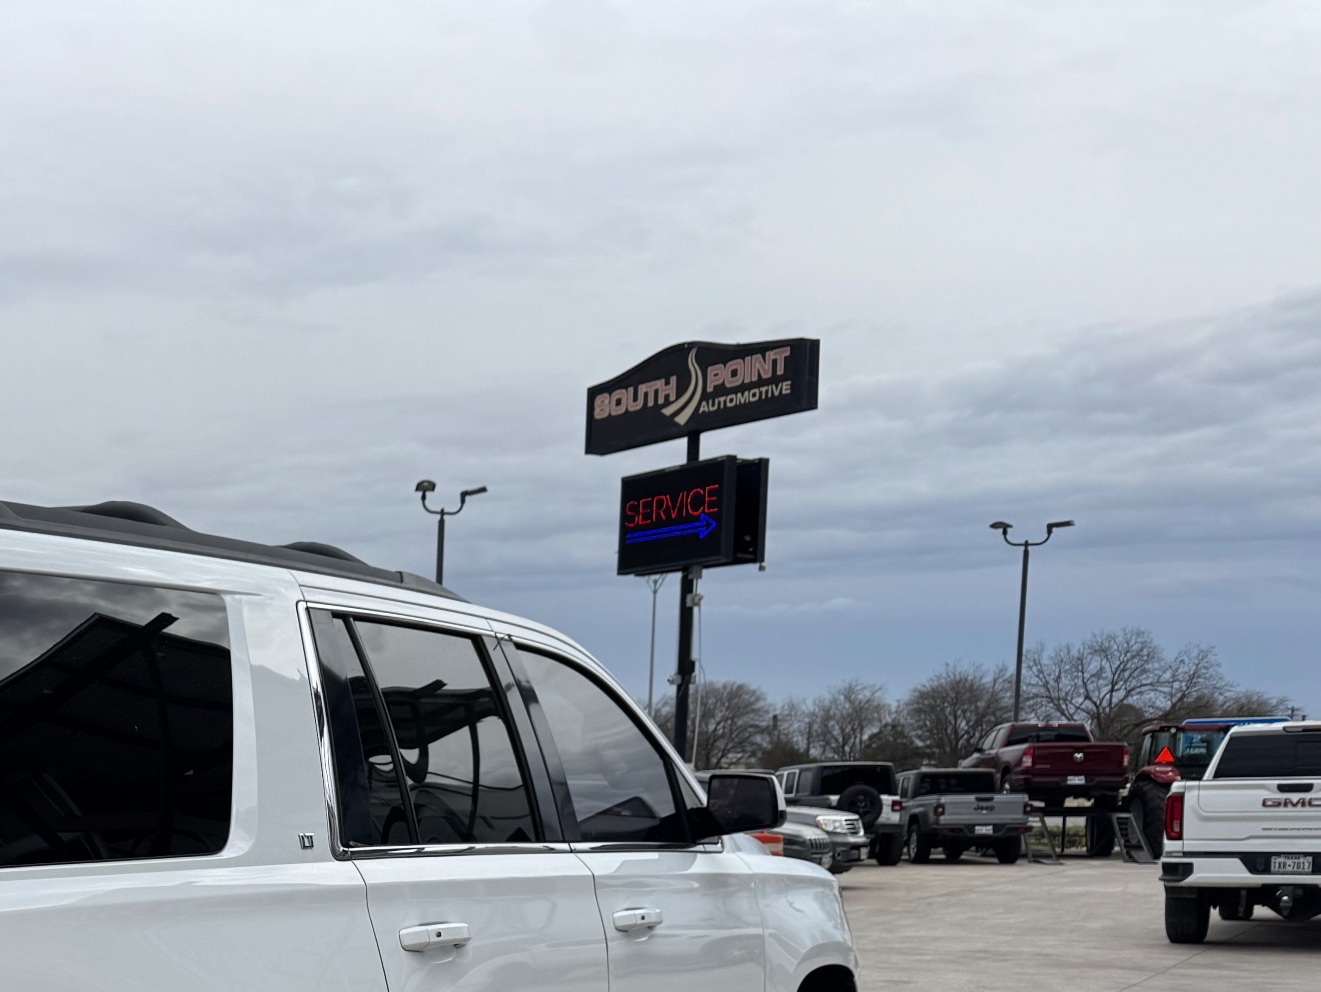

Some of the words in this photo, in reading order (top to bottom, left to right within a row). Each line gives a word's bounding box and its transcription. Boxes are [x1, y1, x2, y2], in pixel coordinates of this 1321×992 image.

[594, 376, 677, 420] SOUTH
[707, 346, 790, 392] POINT
[699, 381, 792, 414] AUTOMOTIVE
[624, 485, 719, 528] SERVICE
[973, 804, 995, 812] Jeep
[1262, 797, 1321, 808] GMC
